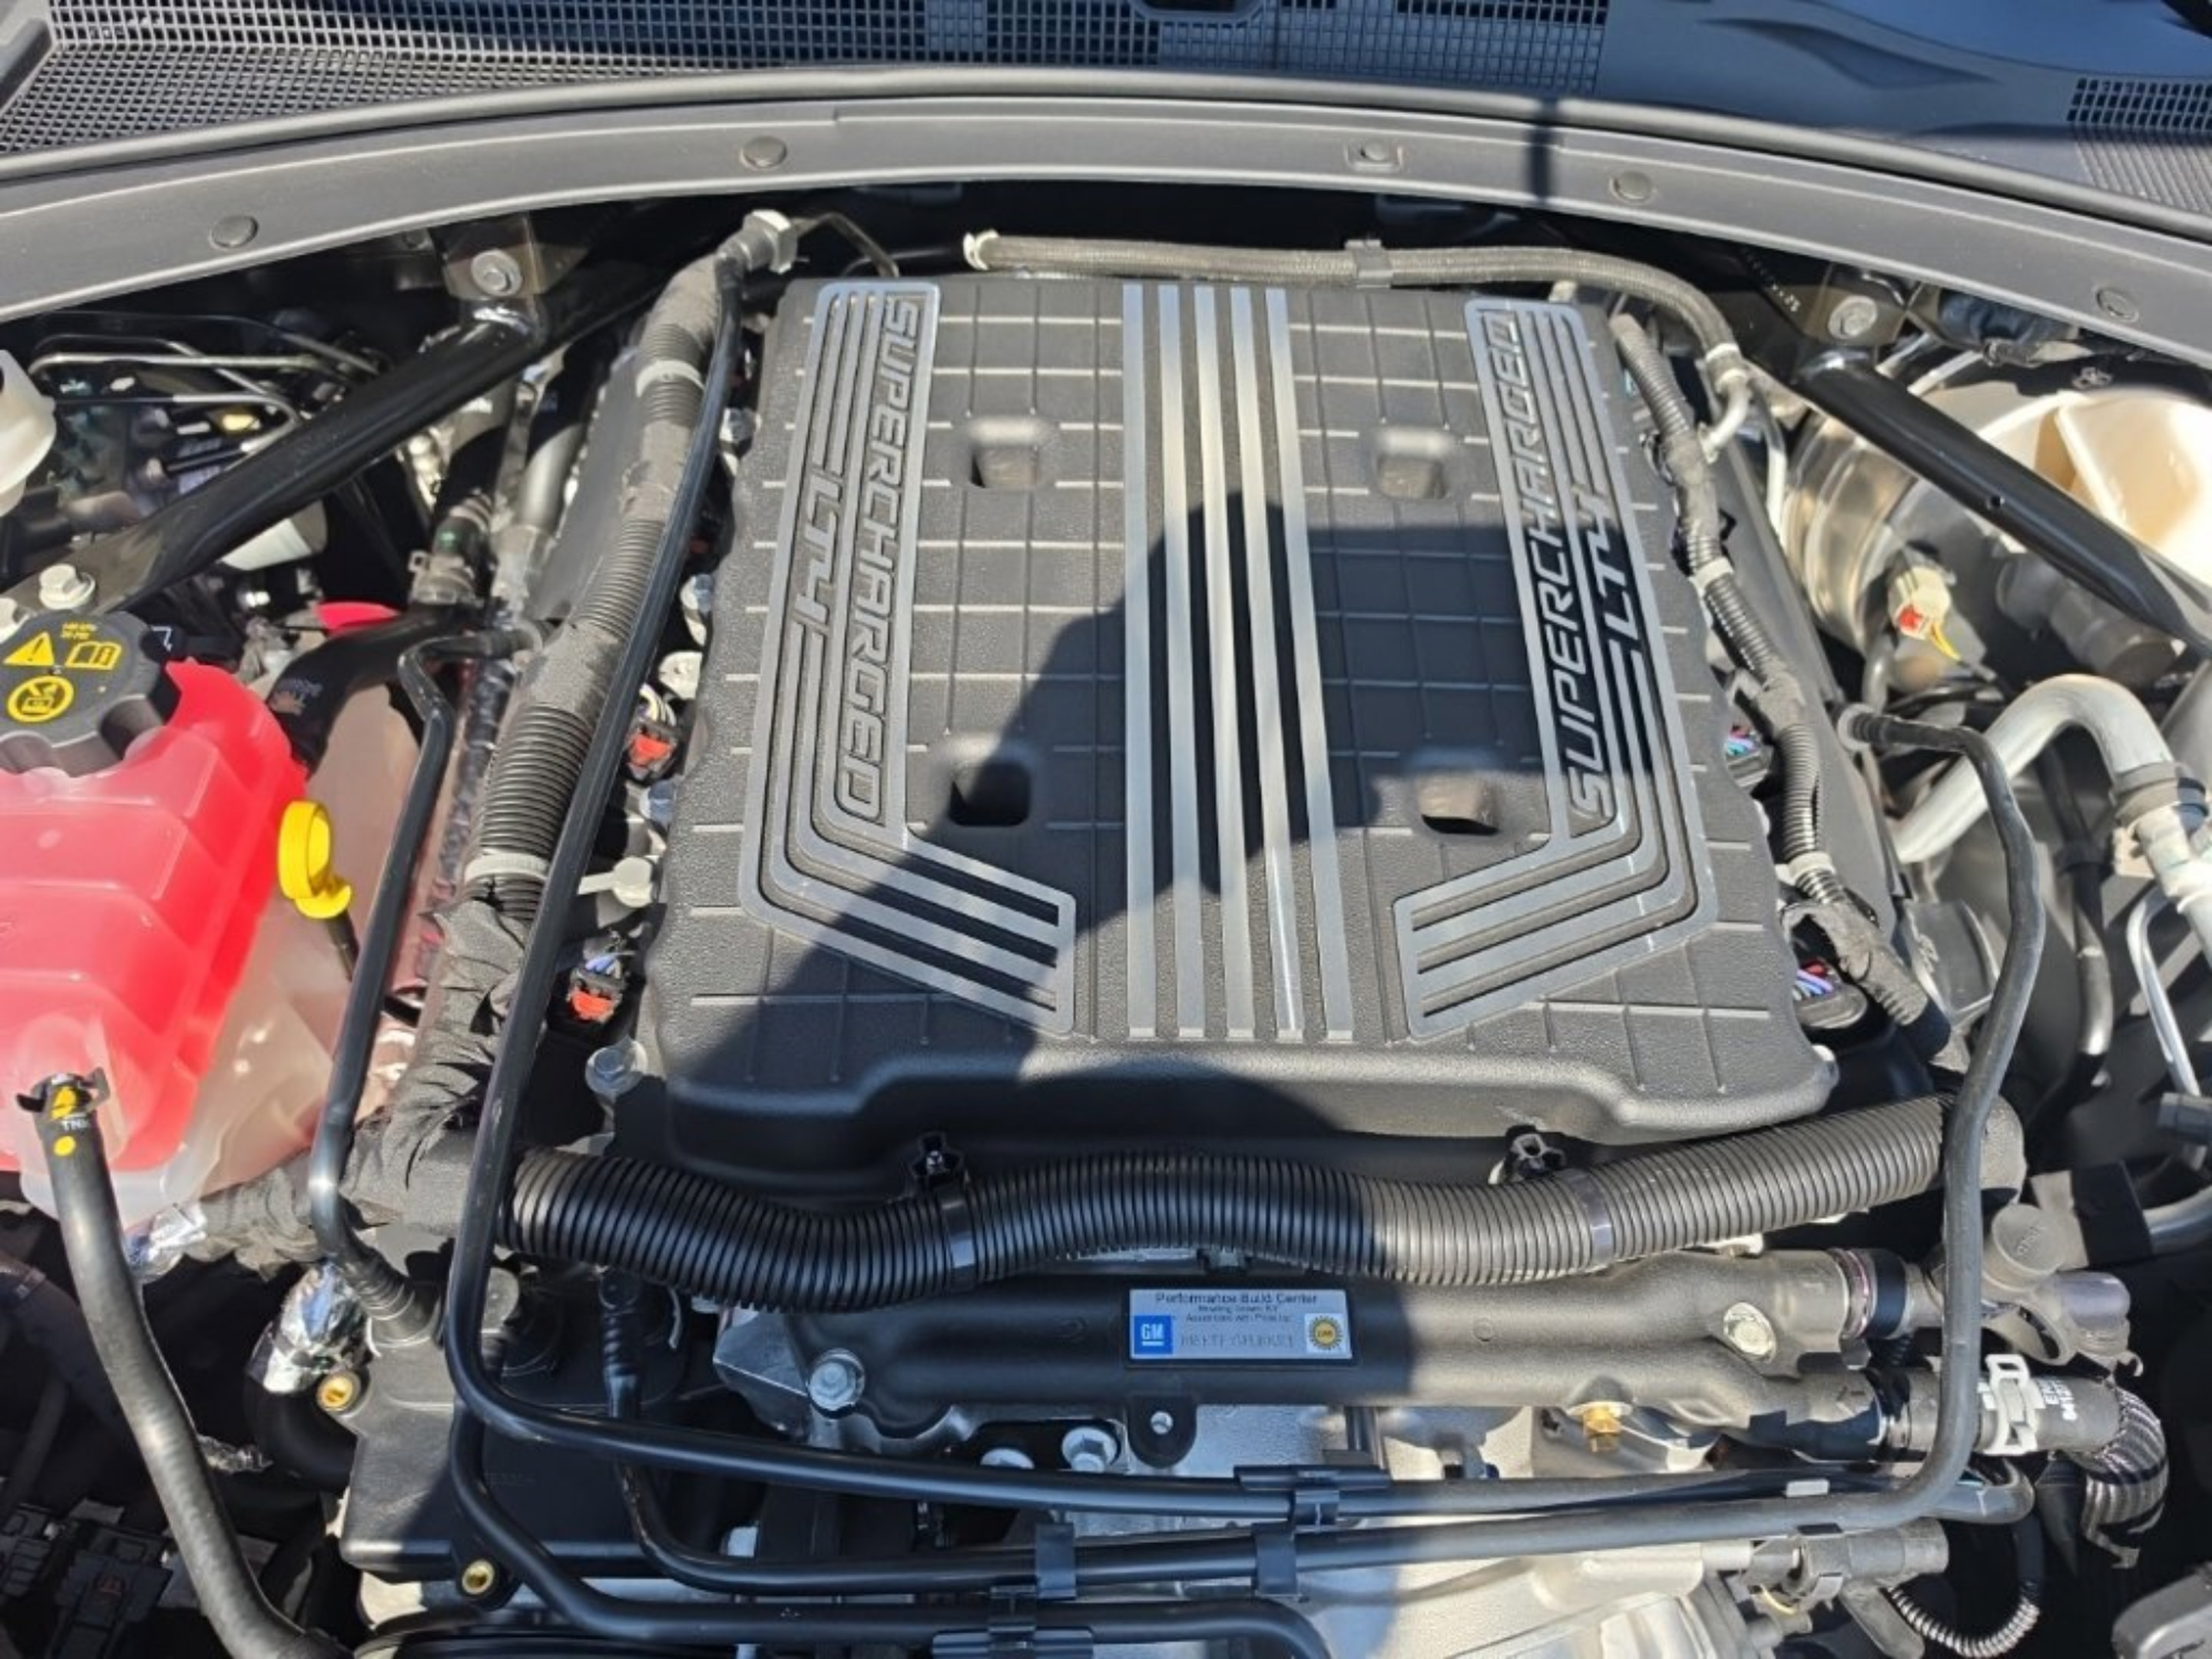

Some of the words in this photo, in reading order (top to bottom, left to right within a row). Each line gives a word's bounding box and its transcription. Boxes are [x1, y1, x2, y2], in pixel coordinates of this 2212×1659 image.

[796, 475, 840, 624] LT4
[842, 298, 918, 821] SUPERCHARGED
[1485, 314, 1612, 816] SUPERCHARGED
[1576, 496, 1636, 643] LT4
[1141, 1323, 1164, 1340] GM
[1155, 1293, 1236, 1304] Performance
[1241, 1293, 1271, 1303] Build
[1276, 1293, 1316, 1304] Center
